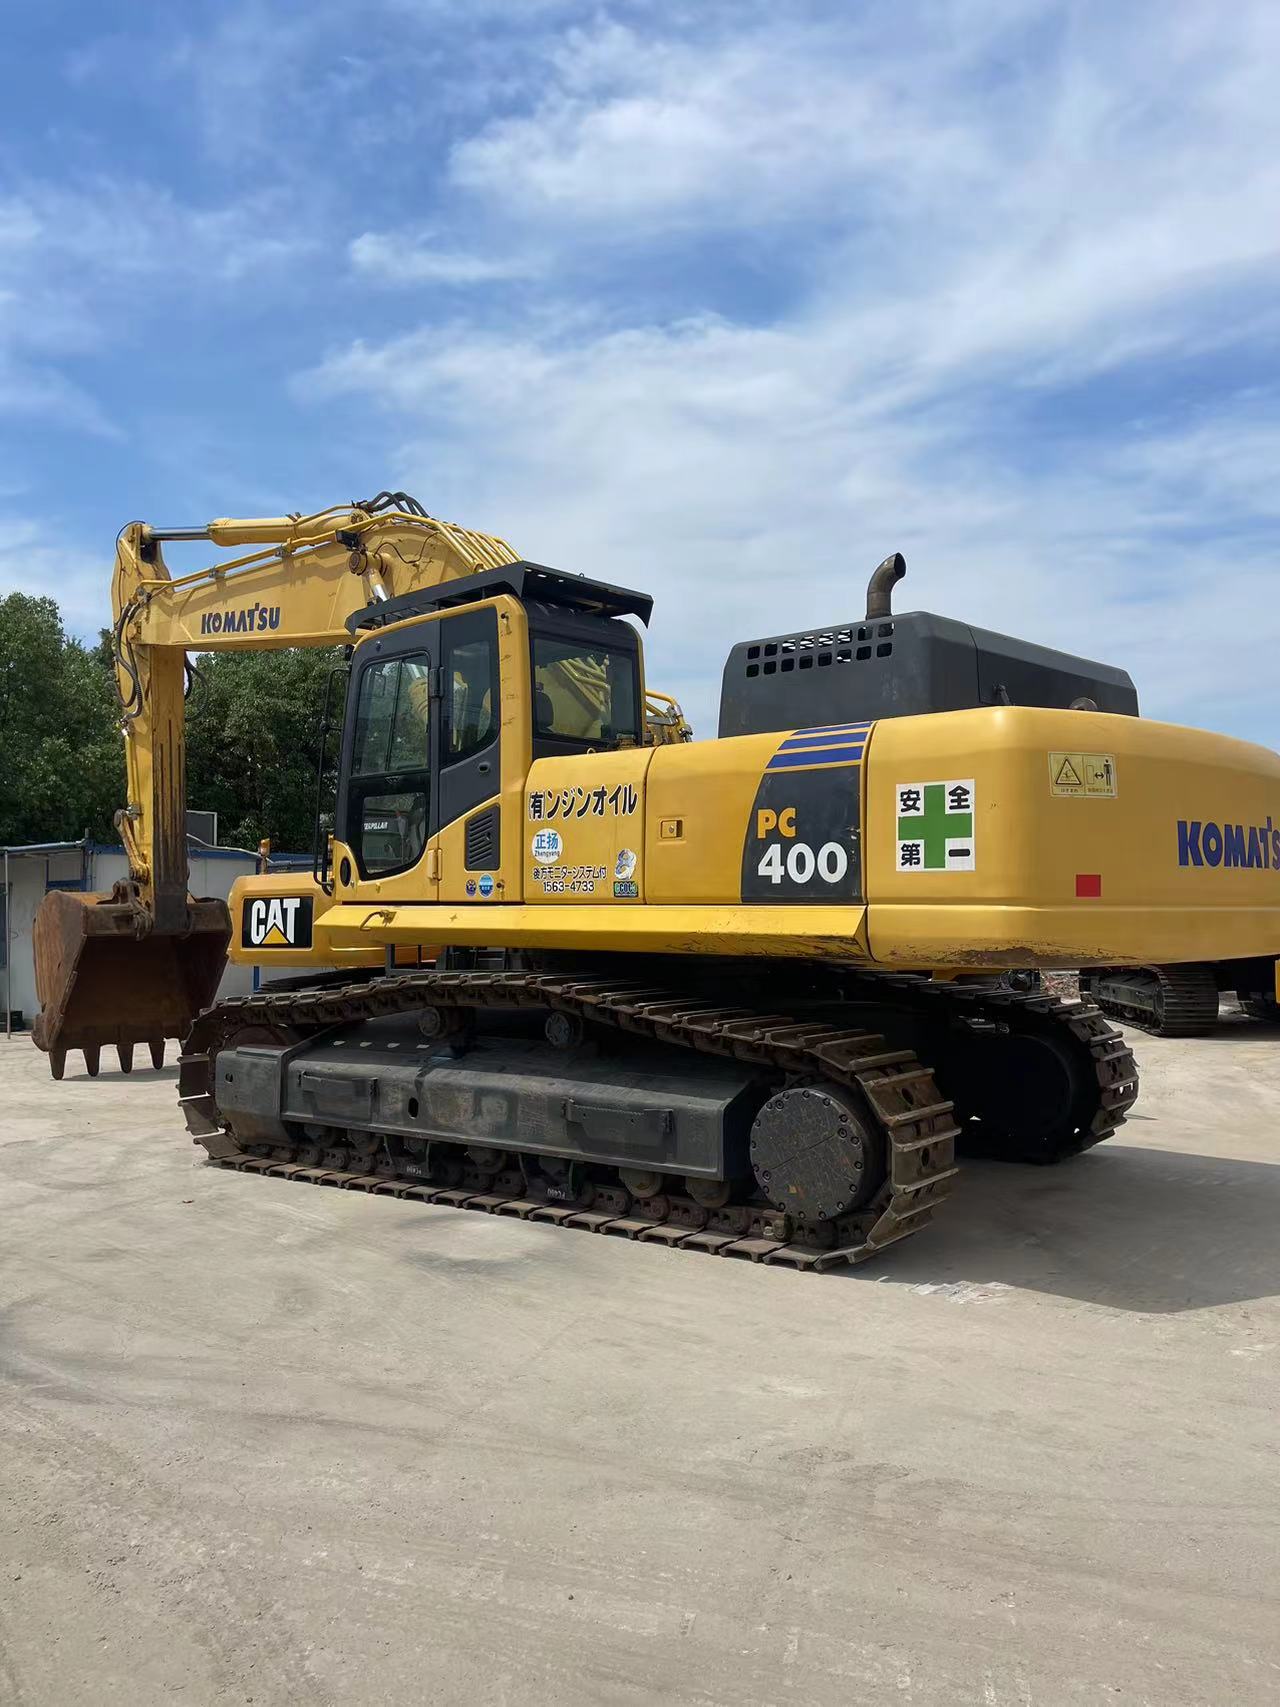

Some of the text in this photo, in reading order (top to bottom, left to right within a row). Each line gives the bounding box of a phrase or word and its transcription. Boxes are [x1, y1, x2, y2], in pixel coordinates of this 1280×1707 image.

[201, 602, 281, 634] KOMATSU
[757, 807, 796, 839] PC
[535, 832, 559, 850] 正扬
[757, 841, 848, 884] 400
[543, 880, 595, 892] 1563-4733
[251, 898, 300, 944] CAT
